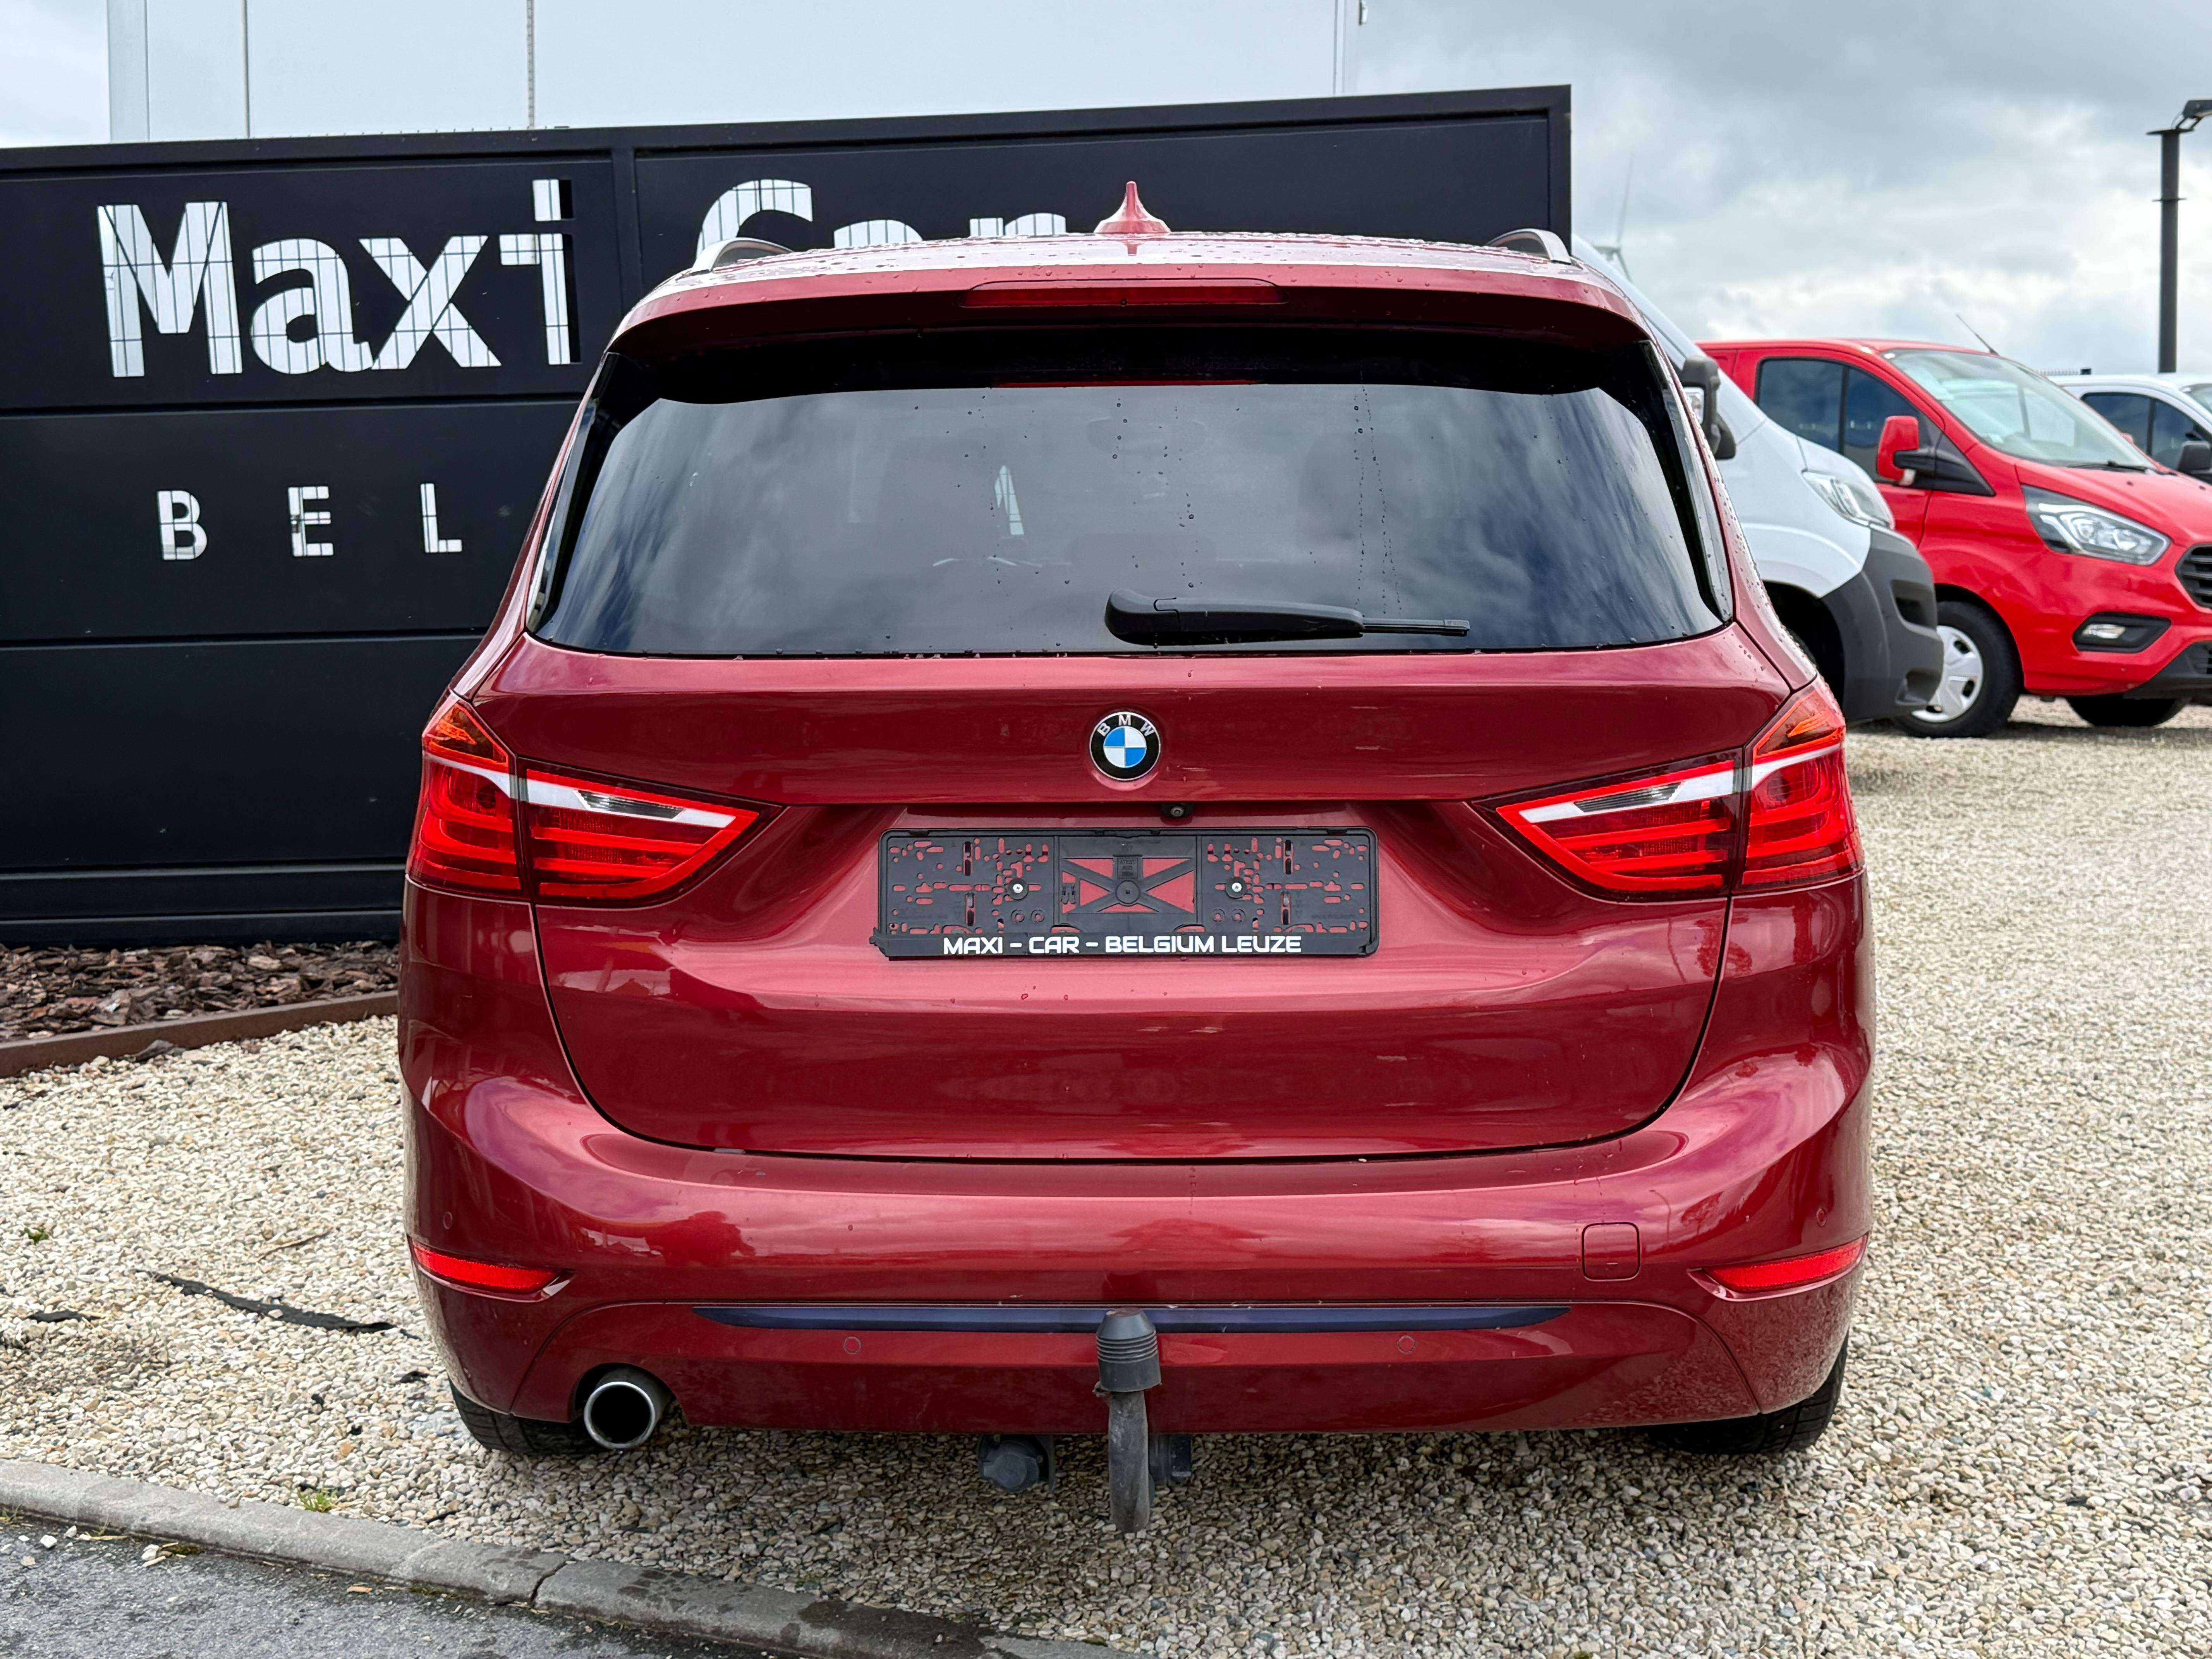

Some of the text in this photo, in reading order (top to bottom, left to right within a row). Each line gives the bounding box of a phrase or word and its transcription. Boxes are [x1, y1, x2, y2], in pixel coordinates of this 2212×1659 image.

[97, 179, 580, 378] Maxi
[1097, 715, 1155, 737] BMW
[943, 936, 1003, 955] MAXI
[1029, 936, 1080, 954] CAR
[1105, 935, 1214, 953] BELGIUM
[1221, 935, 1302, 953] LEUZE
